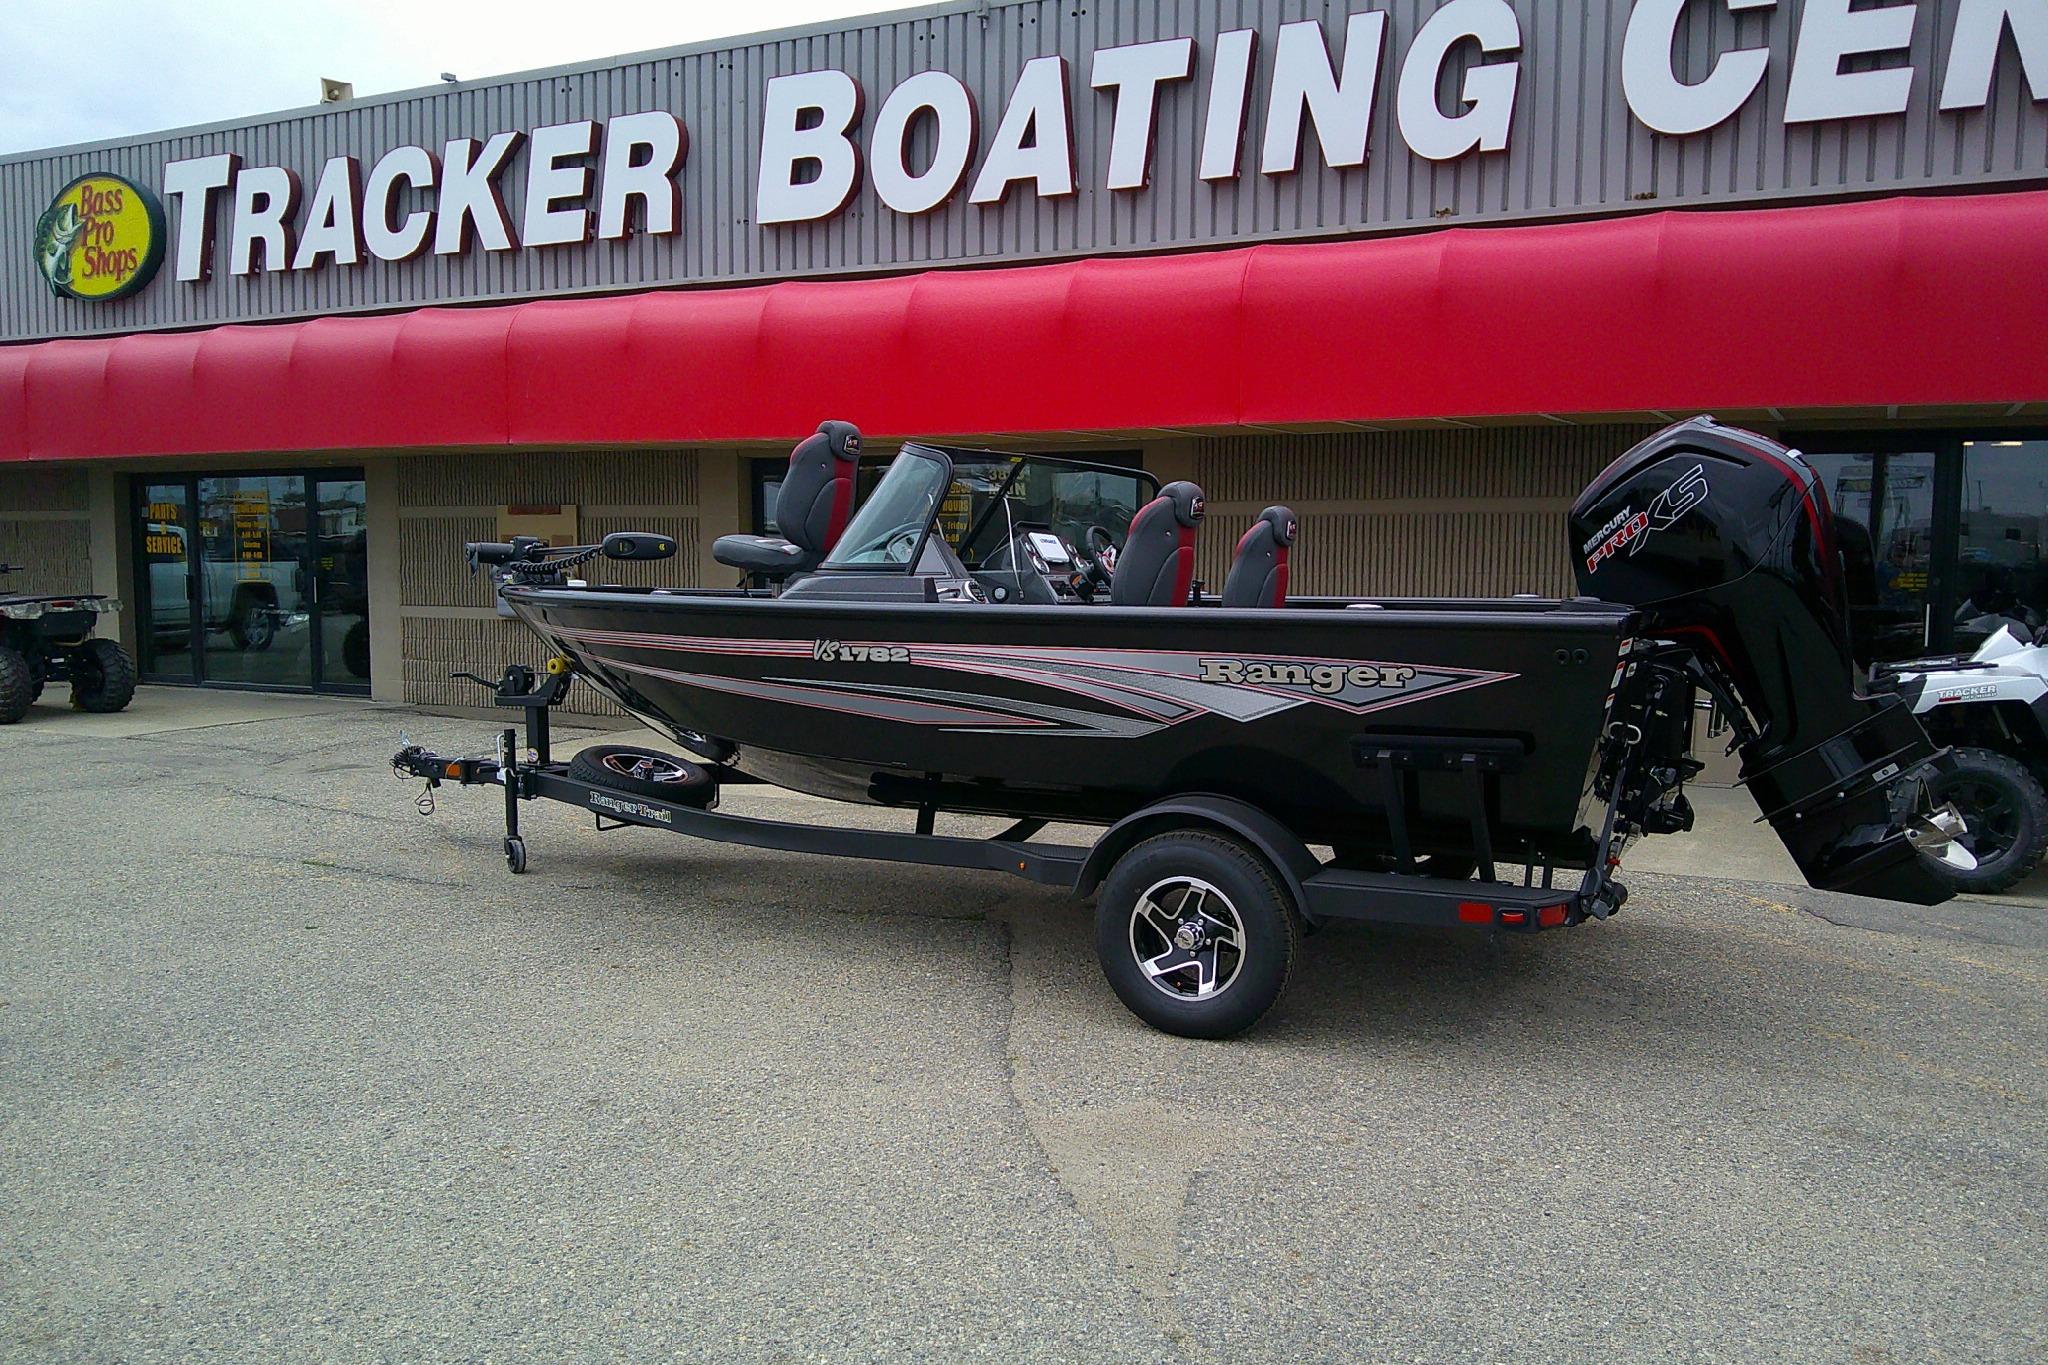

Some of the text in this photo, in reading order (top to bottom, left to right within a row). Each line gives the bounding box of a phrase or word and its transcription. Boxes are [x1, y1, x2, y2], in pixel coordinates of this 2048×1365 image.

[164, 111, 685, 282] TRACKER
[756, 0, 1523, 225] BOATING
[80, 184, 123, 217] Bass
[82, 216, 114, 247] Pro
[82, 246, 138, 283] Shops
[149, 503, 177, 520] PARTS
[1587, 464, 1708, 574] PRO XS
[146, 535, 182, 554] SERVICE
[1583, 505, 1631, 555] MERCURY
[1199, 658, 1417, 695] Ranger
[1938, 684, 1997, 699] TRACKER
[589, 790, 672, 824] Ranger Trail
